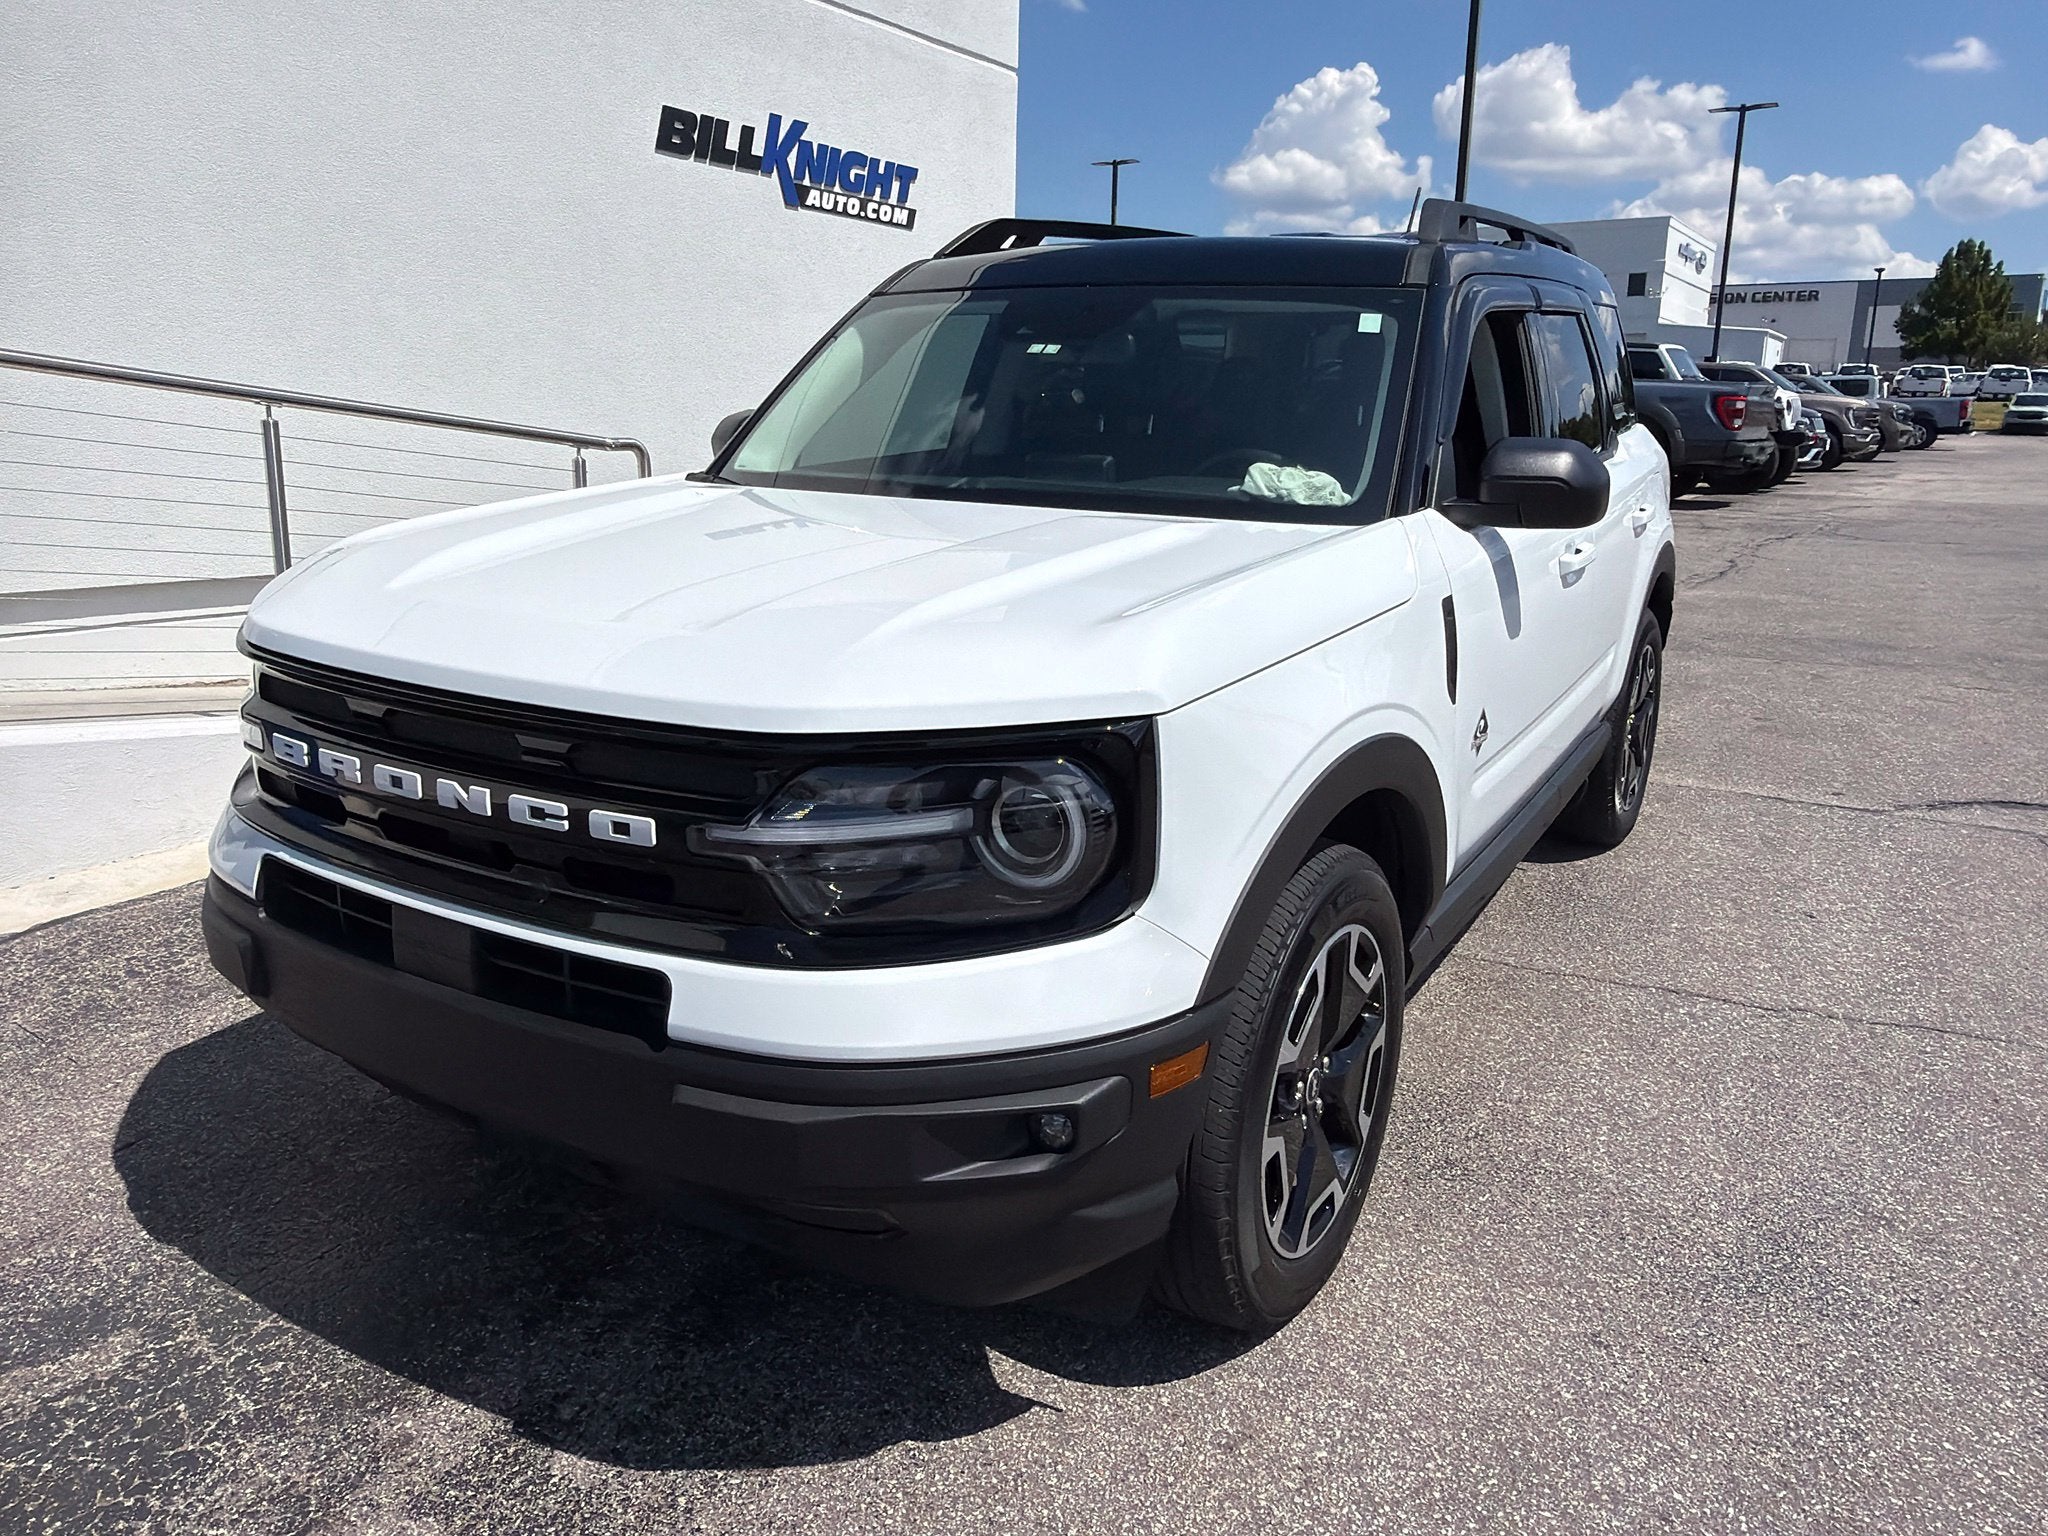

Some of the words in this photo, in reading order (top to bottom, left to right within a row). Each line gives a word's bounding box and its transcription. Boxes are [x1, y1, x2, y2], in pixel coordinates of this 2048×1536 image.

[805, 188, 909, 226] AUTO.COM
[1709, 291, 1748, 305] SON
[1751, 289, 1820, 304] CENTER
[272, 732, 657, 847] BRONCO
